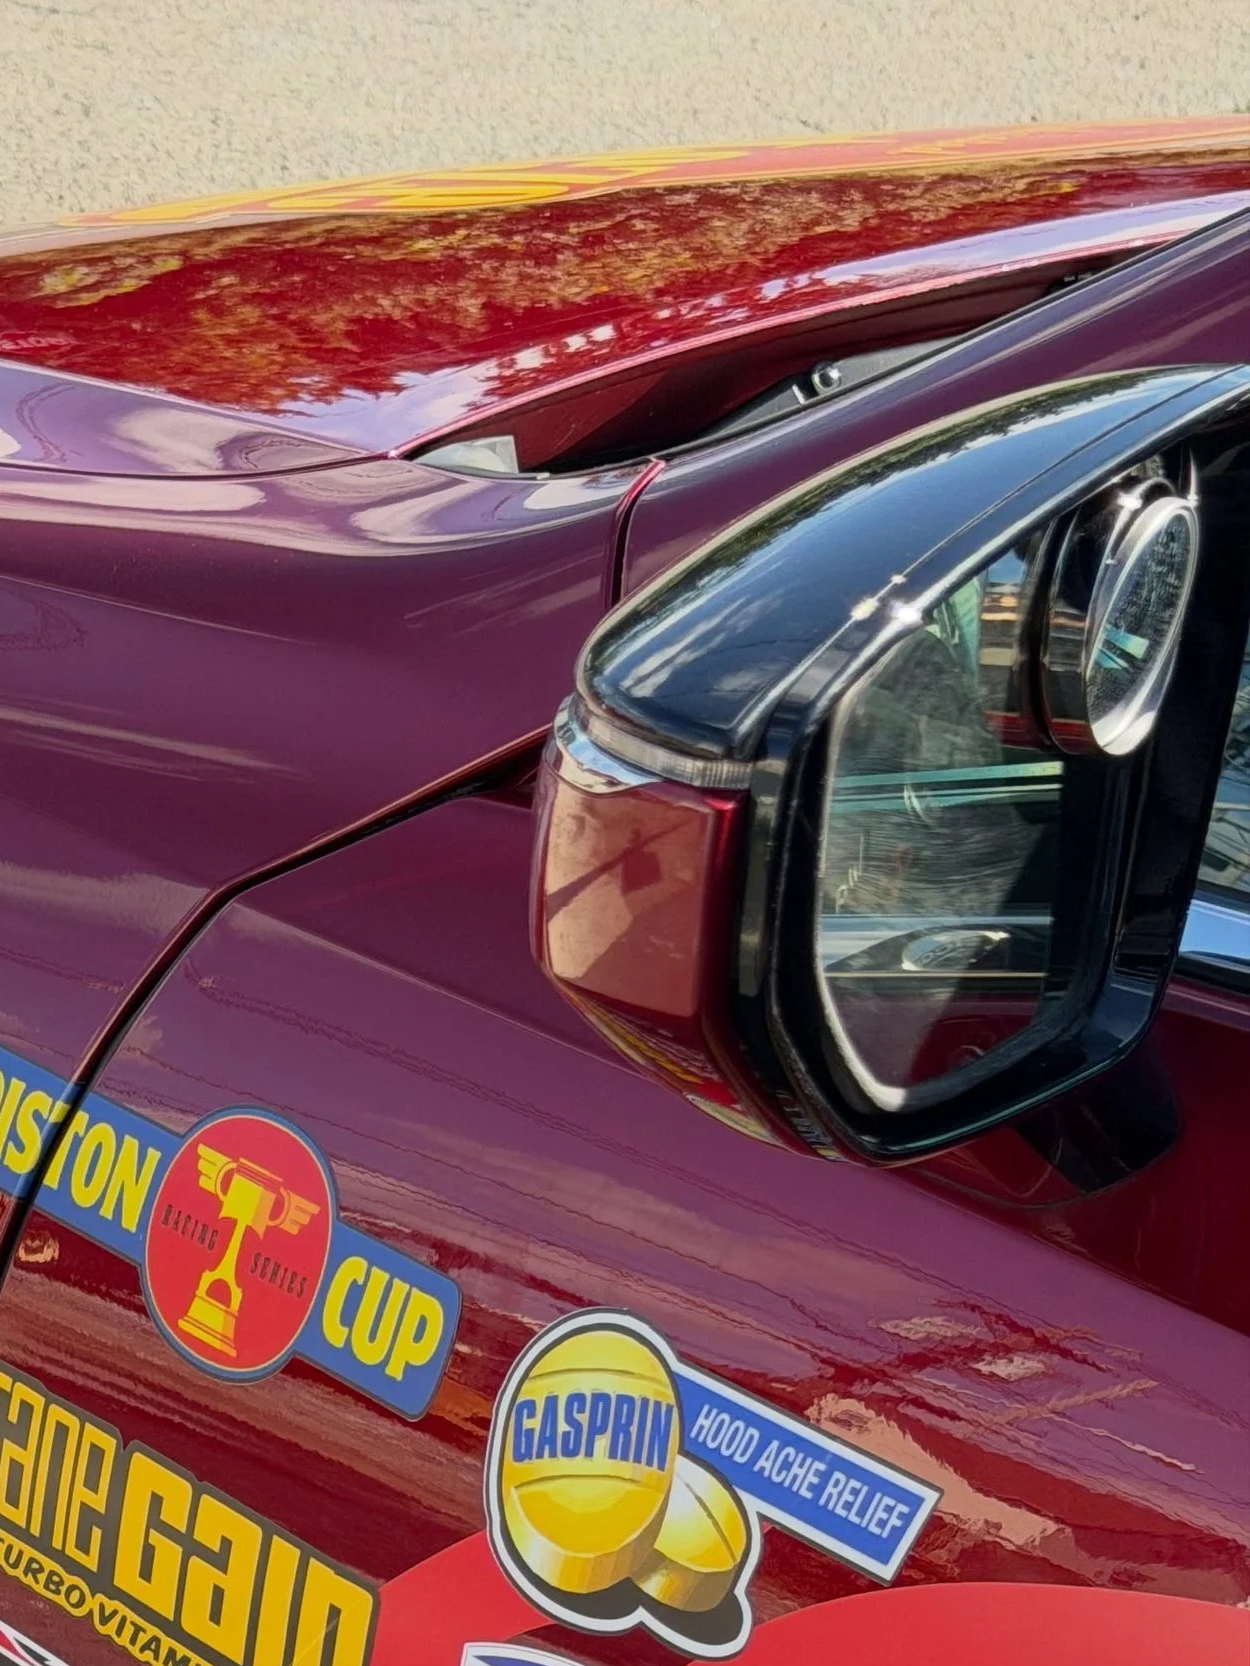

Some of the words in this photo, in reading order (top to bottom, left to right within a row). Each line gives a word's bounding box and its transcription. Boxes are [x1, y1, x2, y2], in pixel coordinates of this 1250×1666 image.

[161, 1203, 219, 1251] RACING
[250, 1252, 308, 1298] SERIES
[322, 1256, 444, 1381] CUP
[511, 1391, 674, 1473] GASPRIN
[690, 1403, 759, 1464] HOOD
[753, 1438, 826, 1501] ACHE
[819, 1472, 910, 1541] RELIEF
